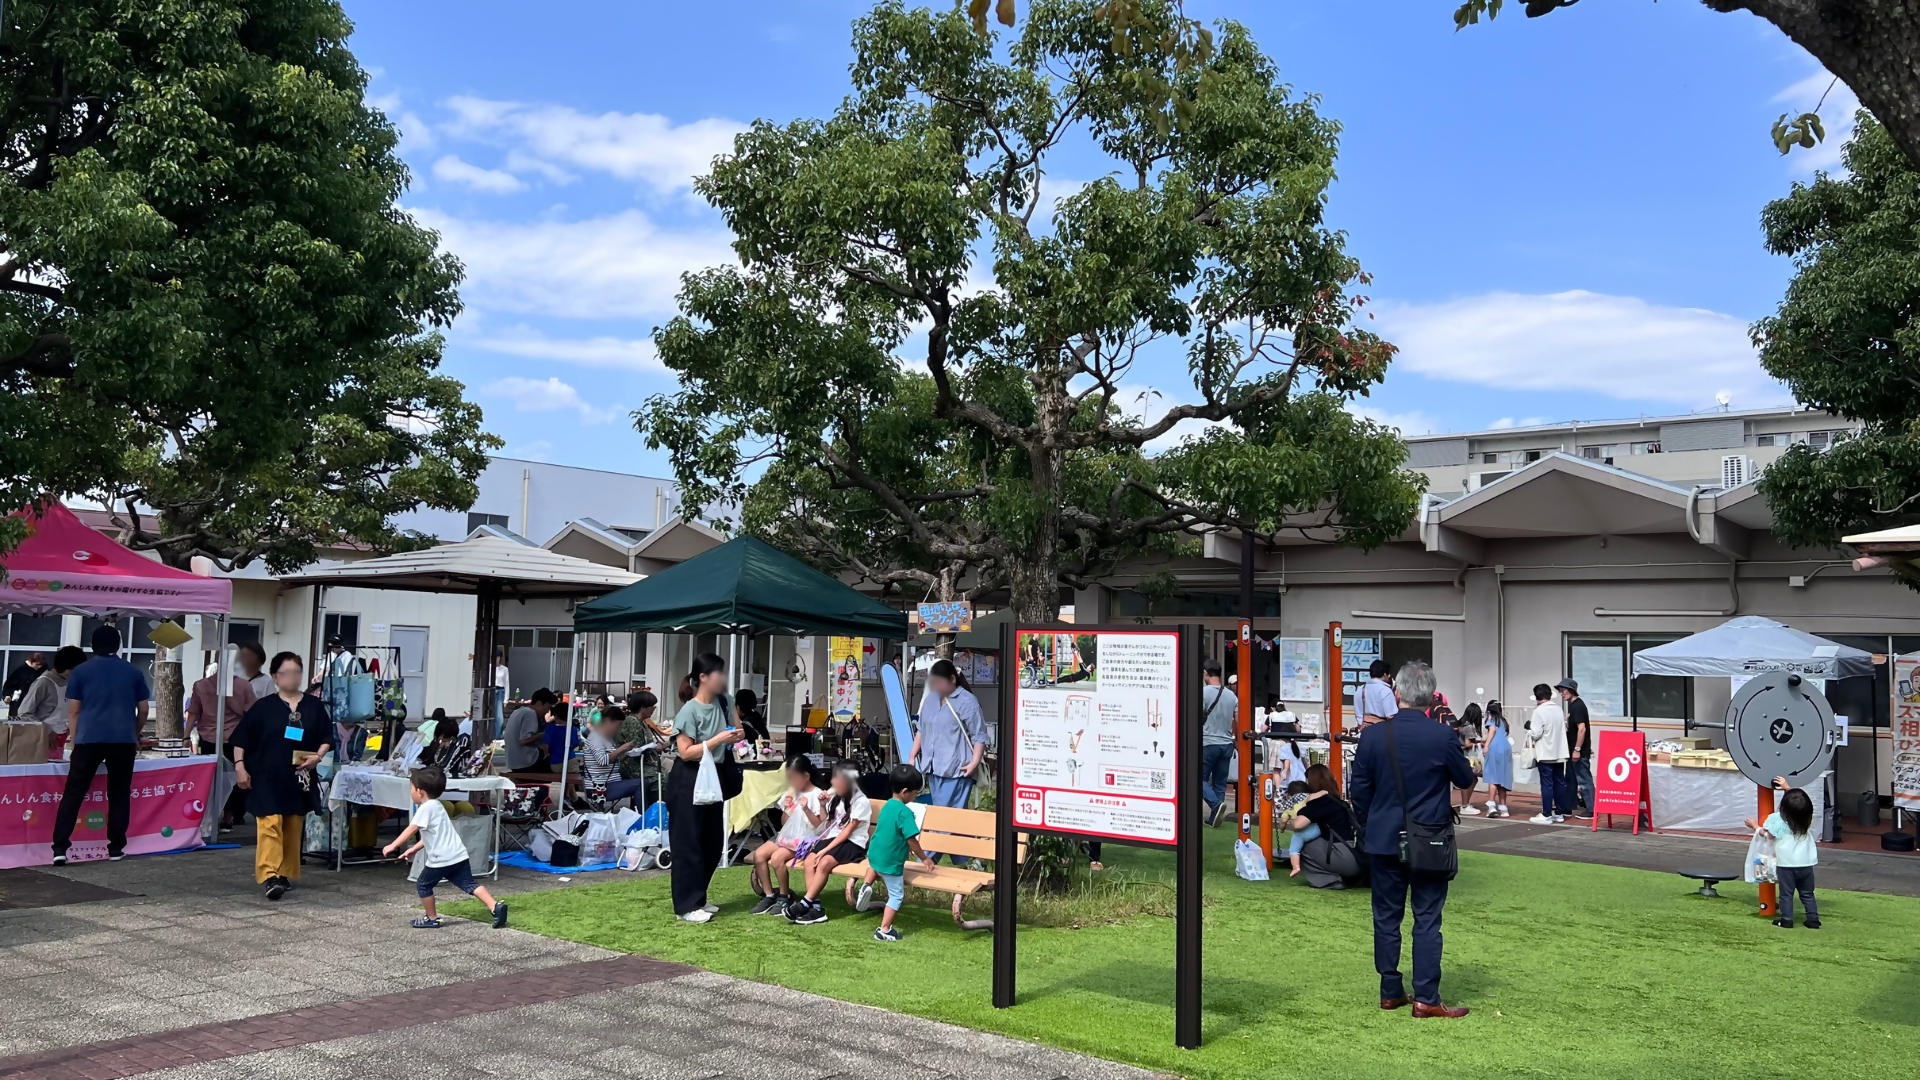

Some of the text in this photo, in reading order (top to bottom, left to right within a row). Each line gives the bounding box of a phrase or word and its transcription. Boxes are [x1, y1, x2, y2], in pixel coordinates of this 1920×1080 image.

[923, 615, 961, 626] マーケット
[1342, 639, 1373, 652] ンタル
